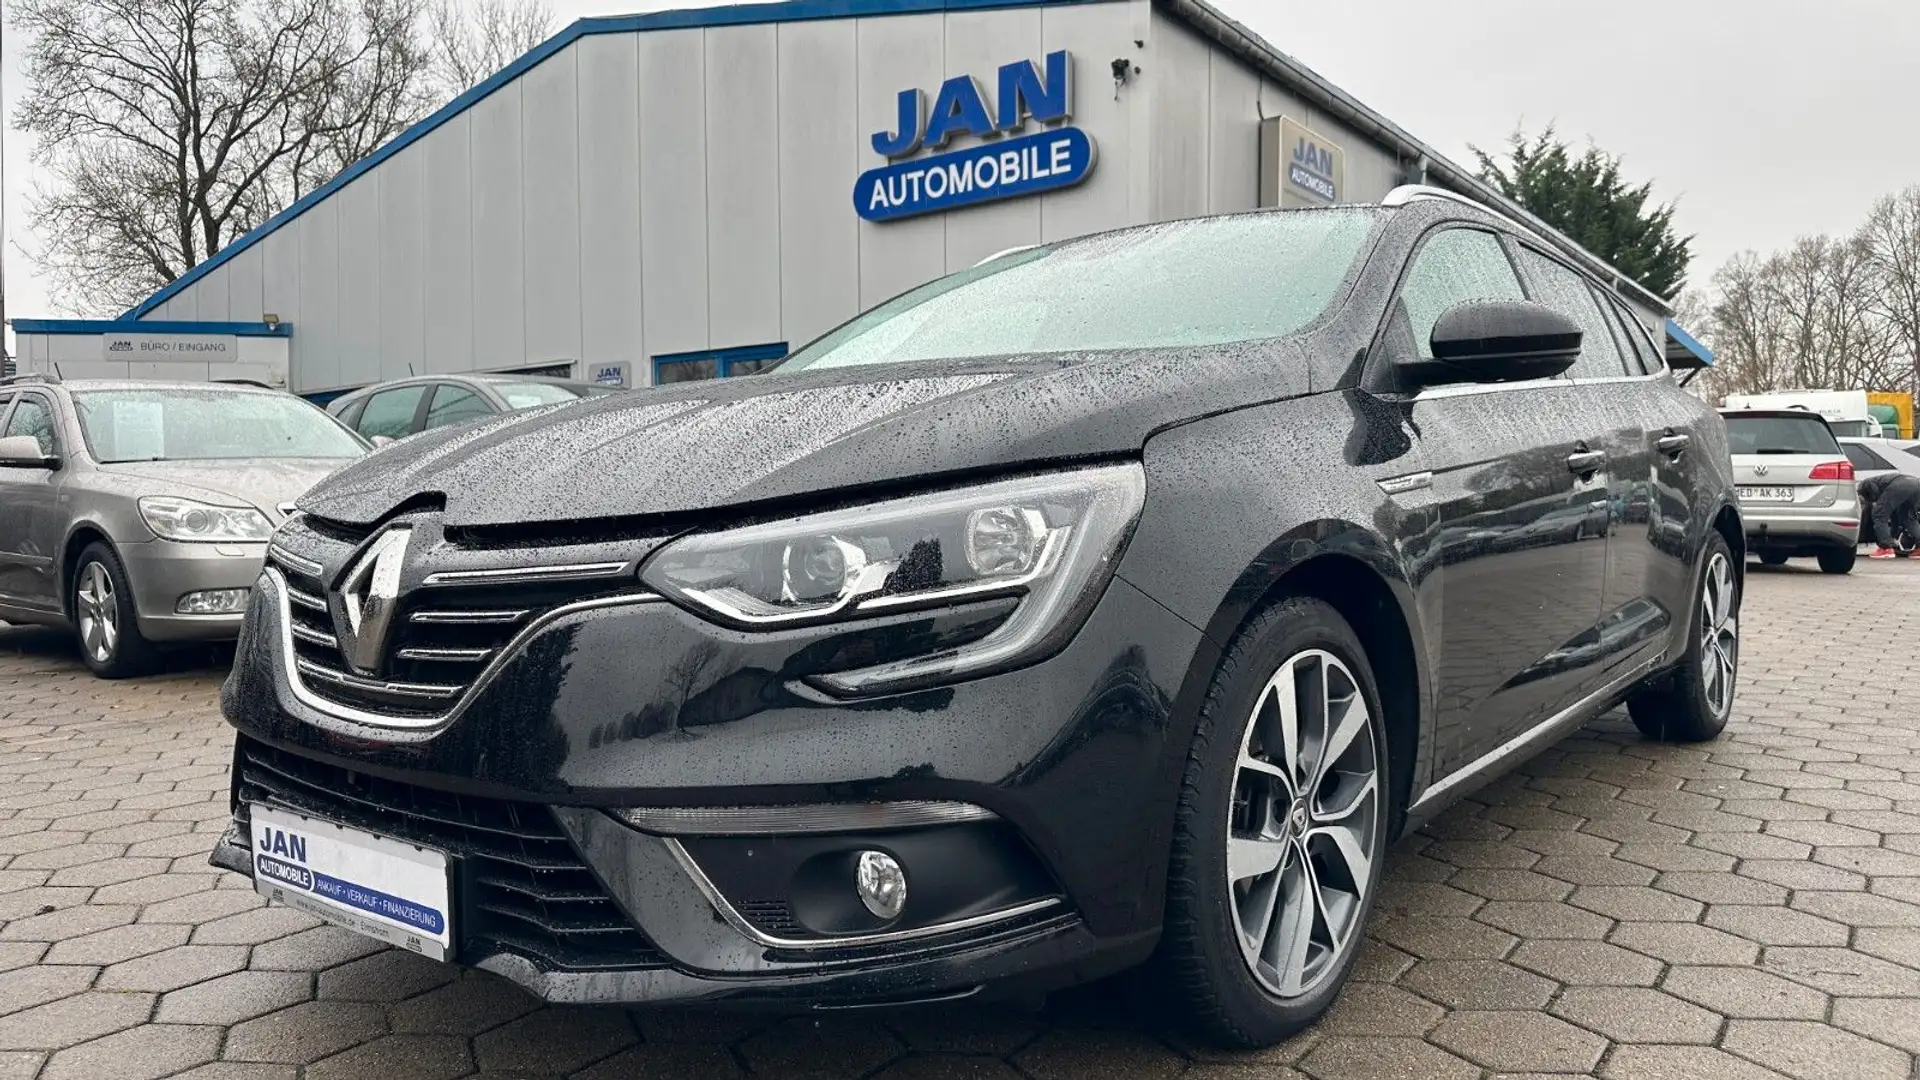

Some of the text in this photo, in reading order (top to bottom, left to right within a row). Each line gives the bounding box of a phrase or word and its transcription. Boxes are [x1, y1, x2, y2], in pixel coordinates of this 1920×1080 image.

[871, 50, 1071, 157] JAN
[1293, 137, 1333, 178] JAN
[869, 139, 1071, 210] AUTOMOBILE
[1291, 167, 1333, 199] AUTOMOBILE
[141, 340, 170, 352] BÜRO
[179, 342, 226, 352] EINGANG
[597, 367, 621, 377] JAN
[1775, 488, 1793, 498] 363
[260, 827, 306, 863] JAN
[260, 859, 309, 886] AUTOMOBILE
[317, 879, 436, 928] ANKAUF VERKAUF FINANZIERUNG
[405, 935, 421, 945] JAN
